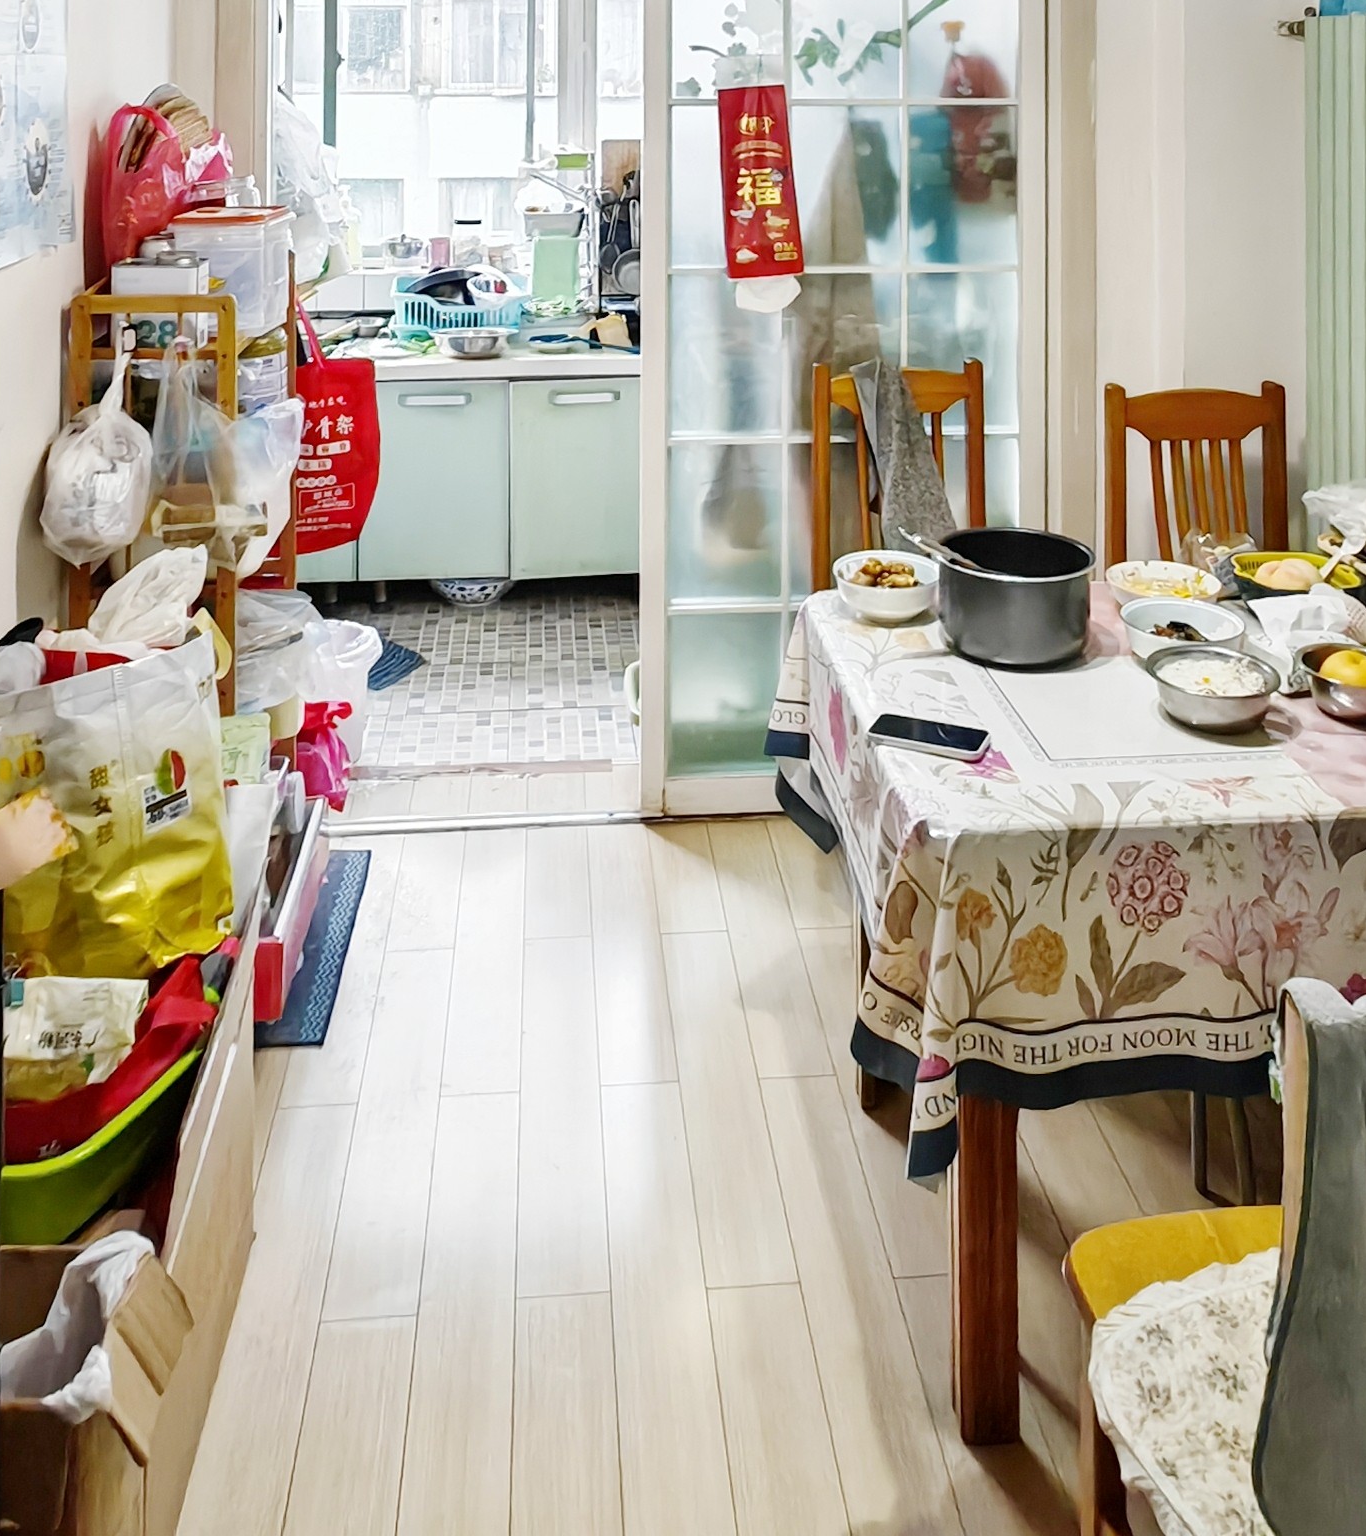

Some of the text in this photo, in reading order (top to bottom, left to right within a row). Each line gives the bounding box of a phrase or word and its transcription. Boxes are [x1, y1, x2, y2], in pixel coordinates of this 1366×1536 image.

[736, 167, 782, 206] 福
[1067, 1033, 1112, 1056] FOR
[1122, 1027, 1197, 1051] MOON
[1206, 1030, 1255, 1053] THE
[1013, 1043, 1063, 1066] THE
